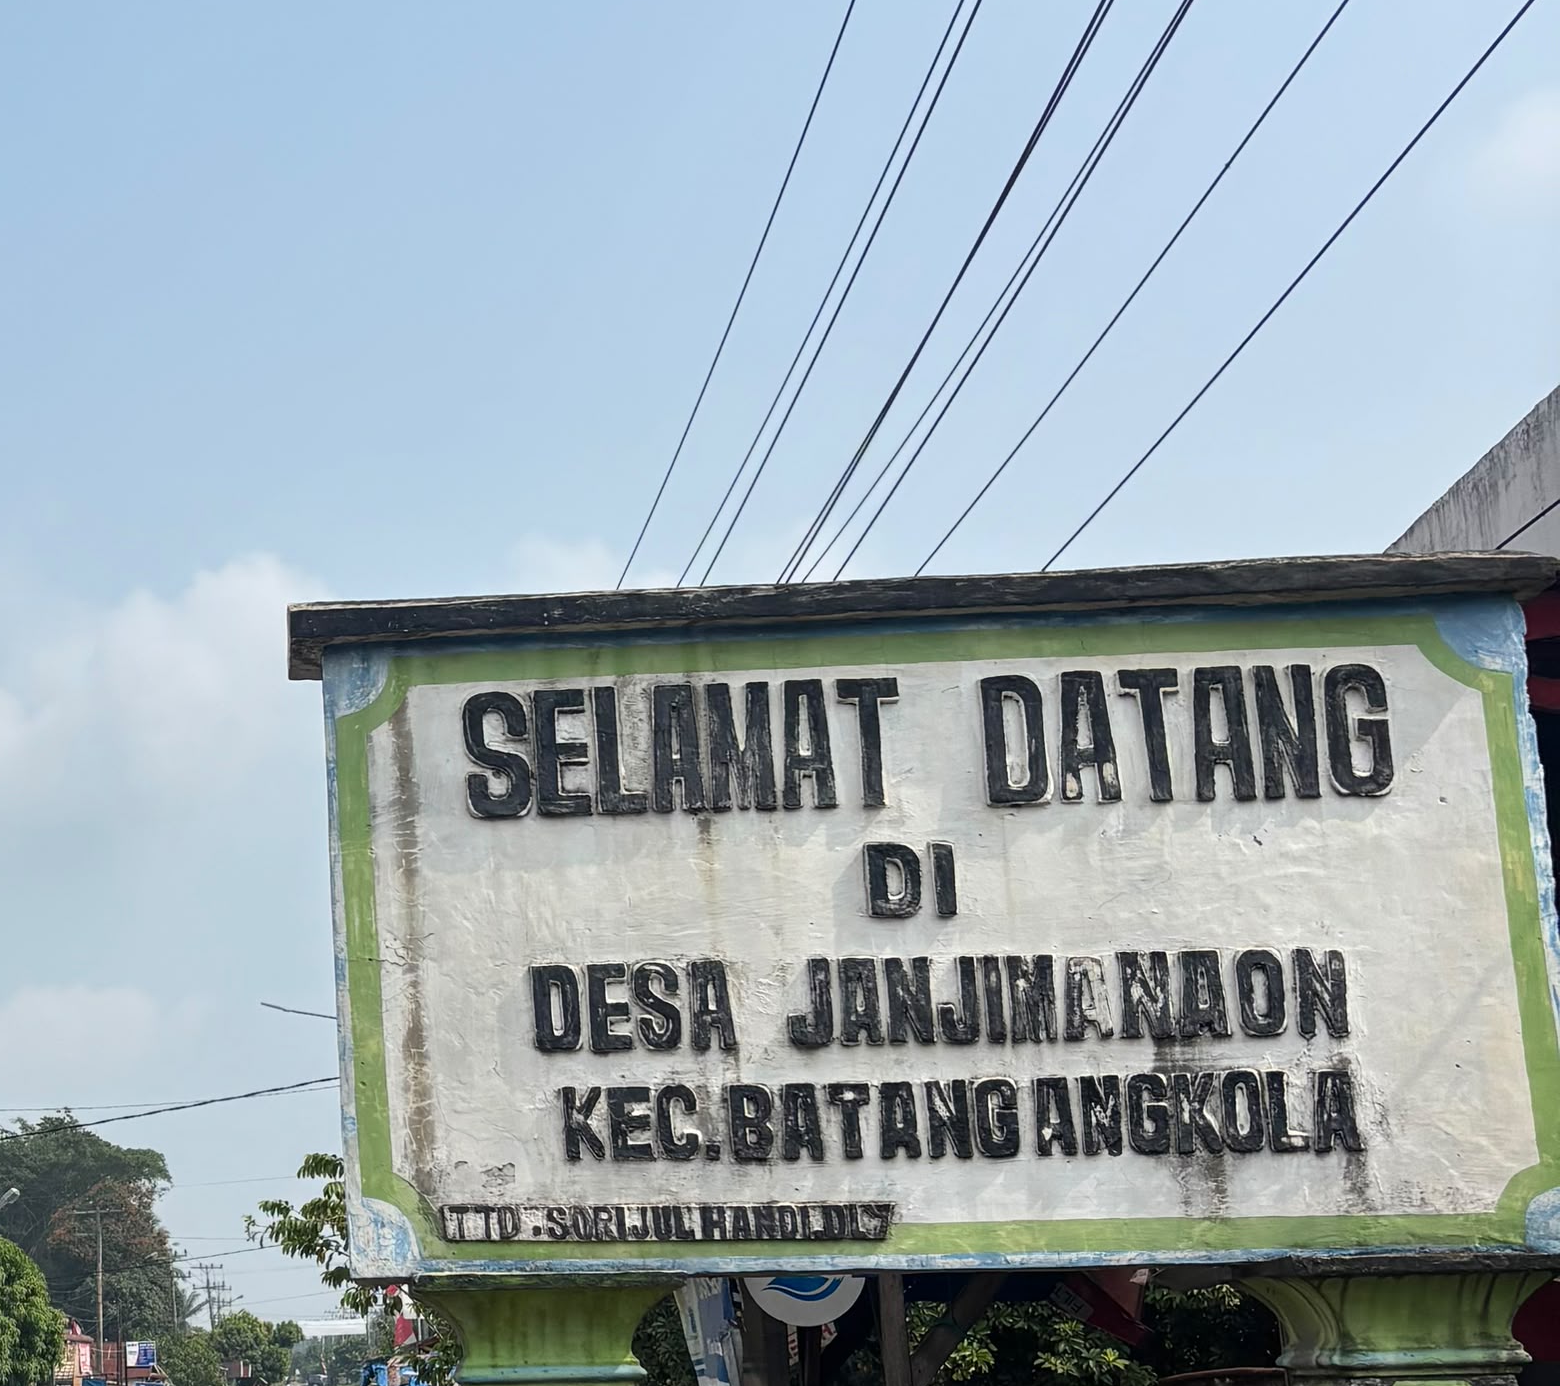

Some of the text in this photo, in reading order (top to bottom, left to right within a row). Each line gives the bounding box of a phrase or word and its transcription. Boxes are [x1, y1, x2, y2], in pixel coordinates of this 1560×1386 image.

[462, 662, 1394, 819] SELAMAT DATANG
[863, 841, 958, 918] DI
[529, 958, 738, 1053] DESA
